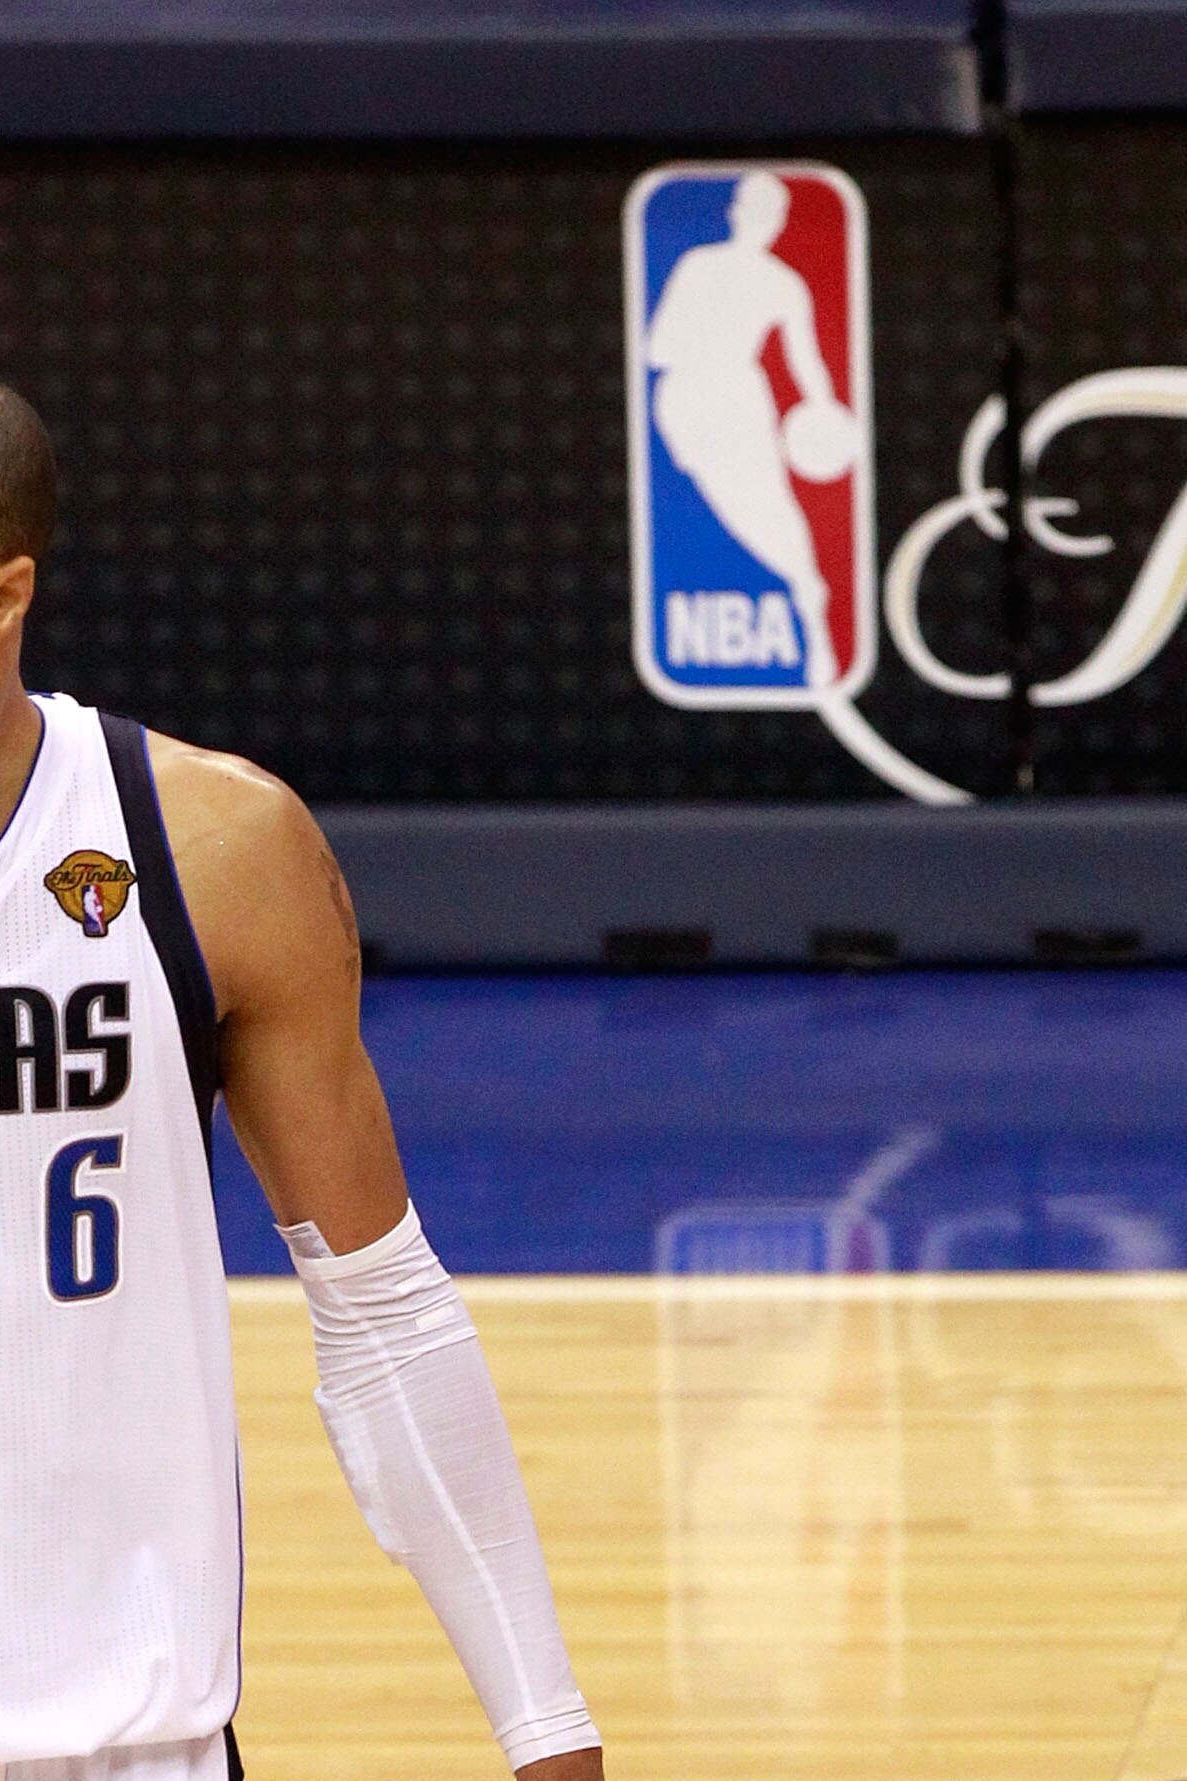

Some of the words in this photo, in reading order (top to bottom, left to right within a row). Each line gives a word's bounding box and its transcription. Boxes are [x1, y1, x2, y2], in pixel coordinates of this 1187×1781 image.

[665, 590, 800, 668] NBA
[64, 863, 130, 887] Finals
[44, 1133, 125, 1303] 6
